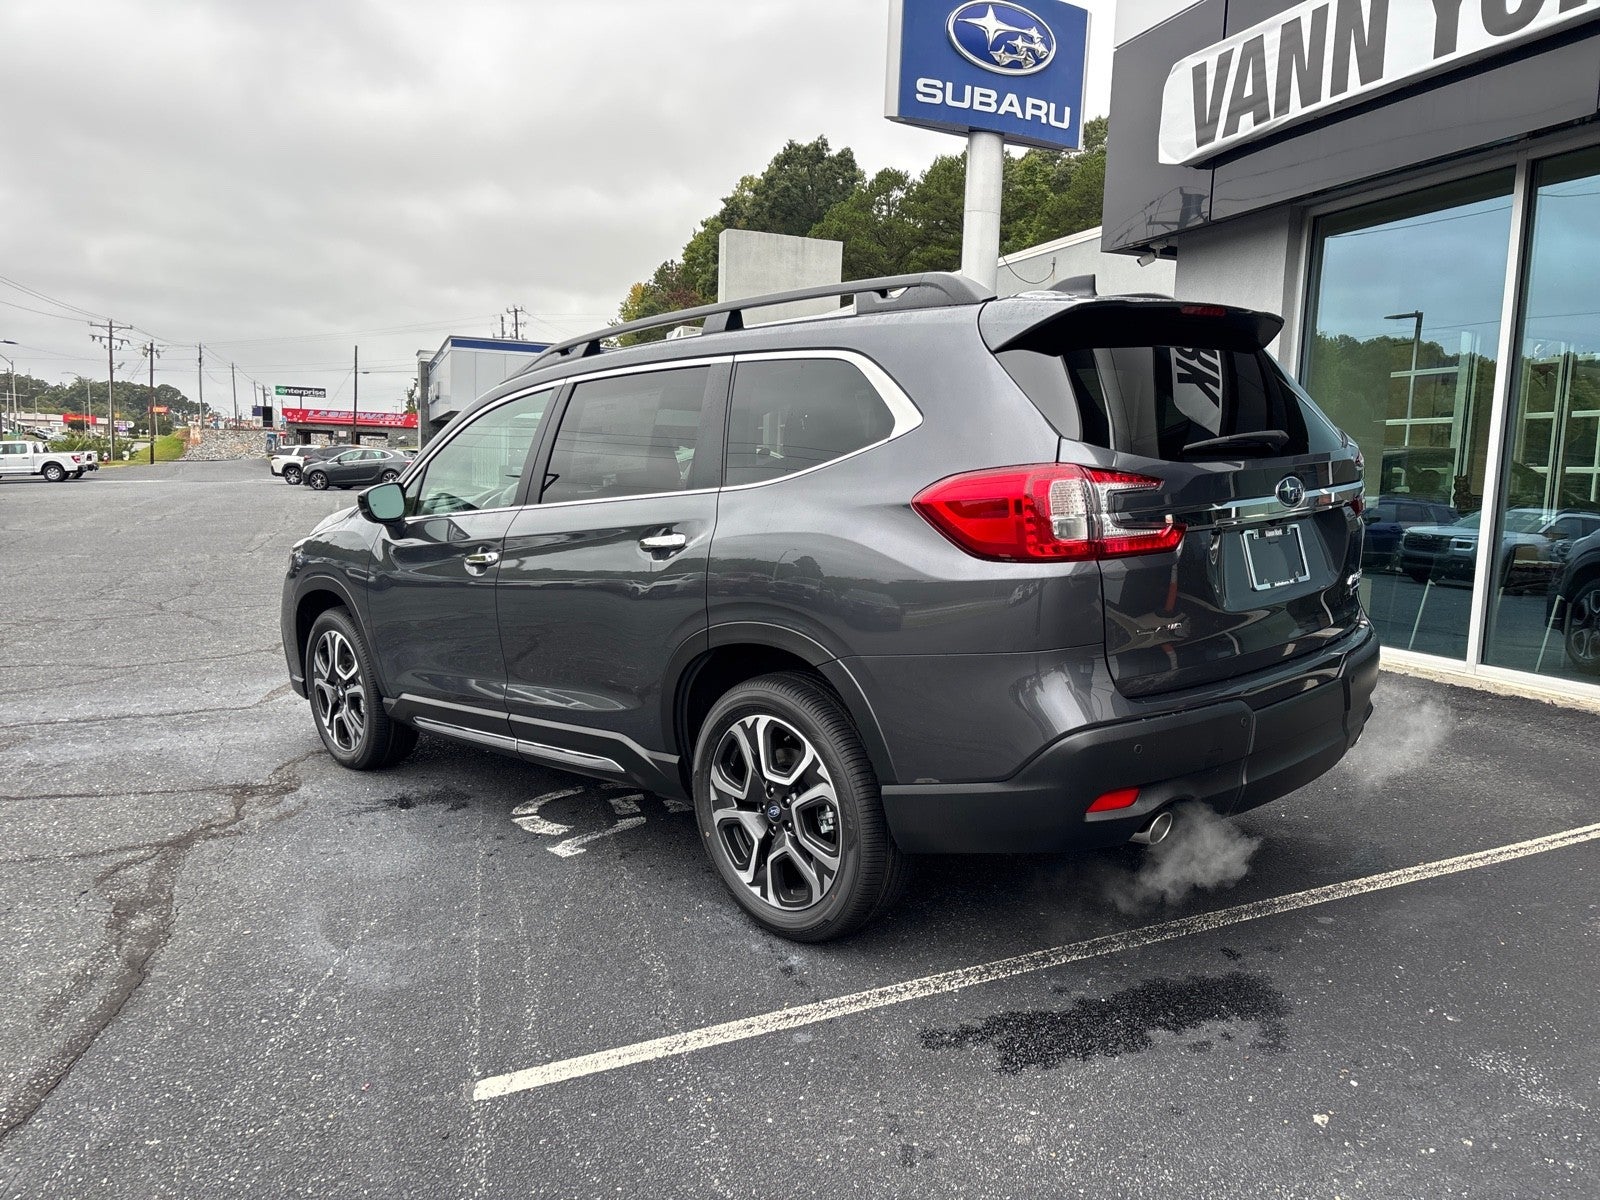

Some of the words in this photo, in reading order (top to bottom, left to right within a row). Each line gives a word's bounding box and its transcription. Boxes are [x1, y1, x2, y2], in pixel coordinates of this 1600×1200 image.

[1191, 0, 1389, 149] VANN
[915, 77, 1071, 129] SUBARU
[277, 387, 325, 396] enterprise
